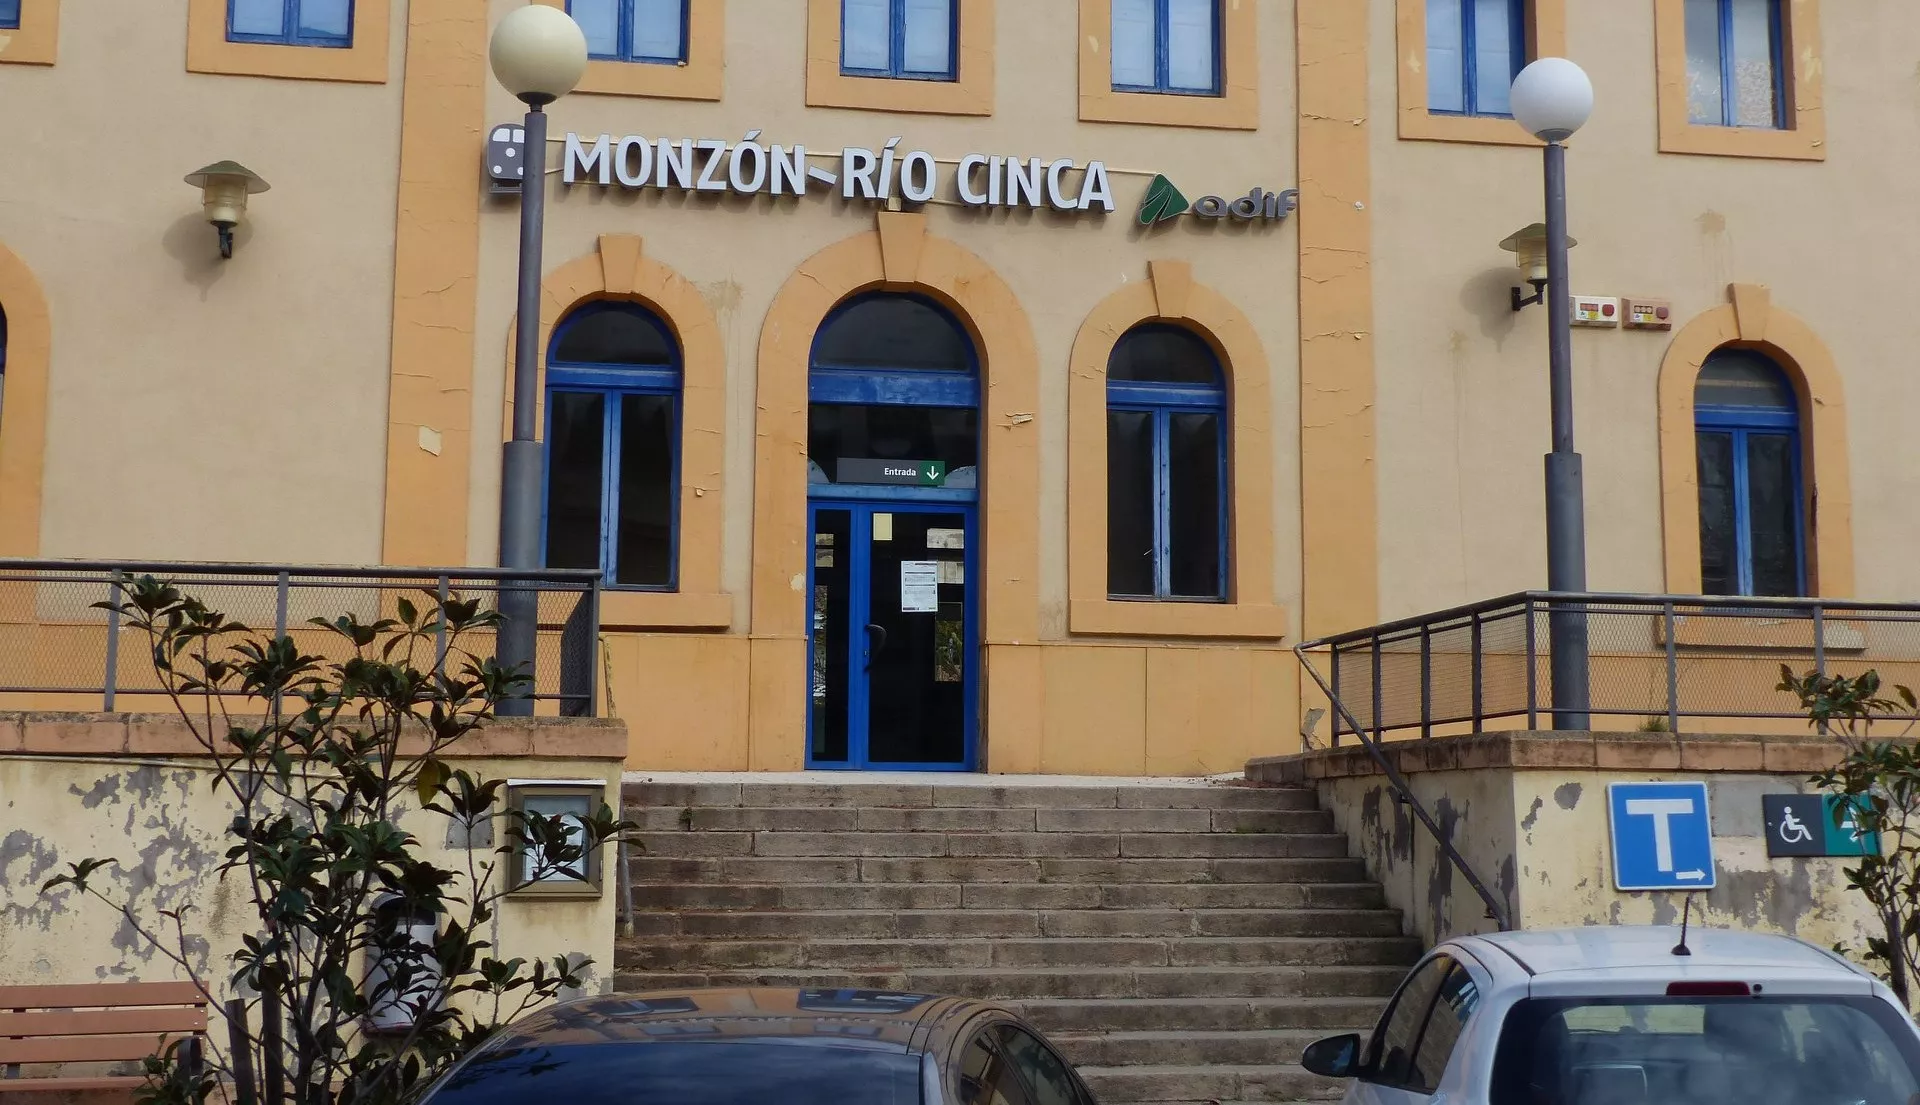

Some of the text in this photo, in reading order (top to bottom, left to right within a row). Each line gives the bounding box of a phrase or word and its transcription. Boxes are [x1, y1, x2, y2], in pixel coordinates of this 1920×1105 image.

[957, 153, 1115, 211] CINCA
[1193, 186, 1299, 219] adif
[884, 467, 917, 476] Entrada
